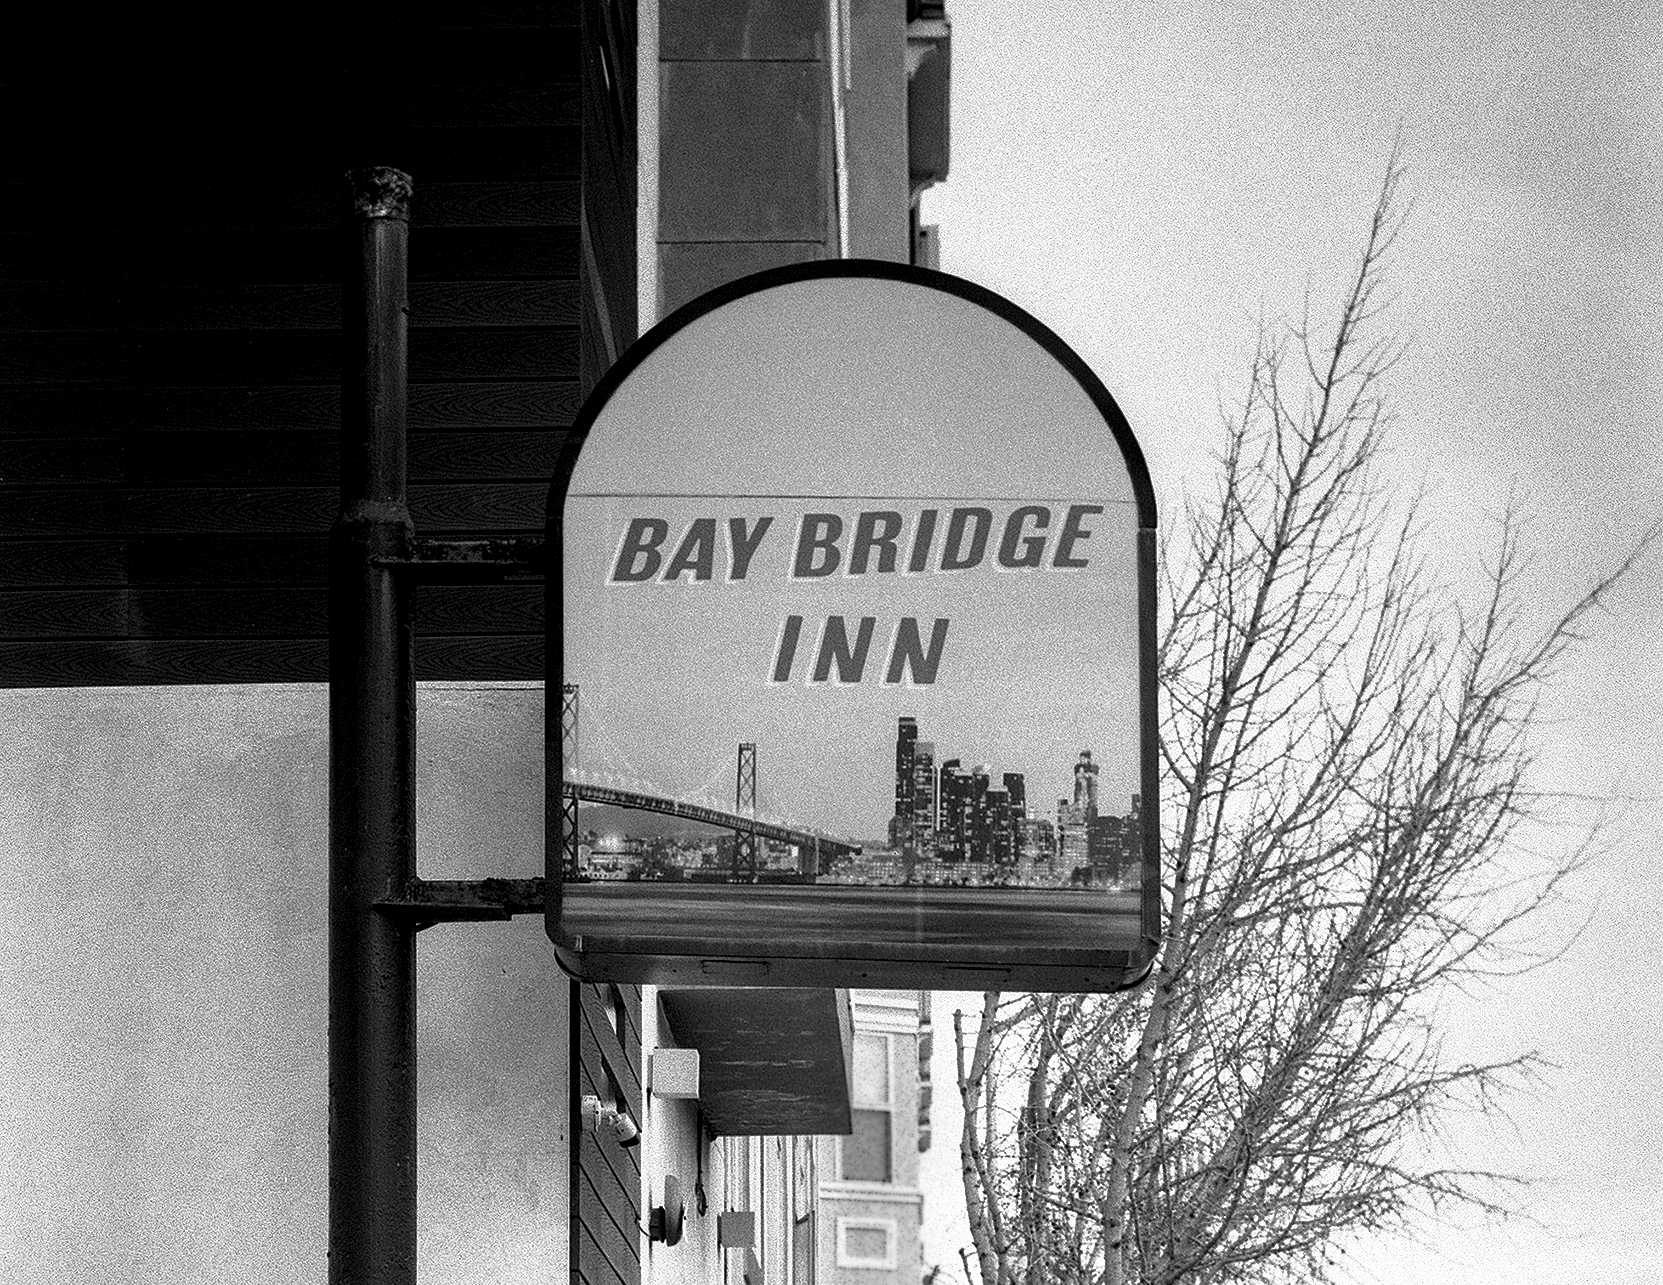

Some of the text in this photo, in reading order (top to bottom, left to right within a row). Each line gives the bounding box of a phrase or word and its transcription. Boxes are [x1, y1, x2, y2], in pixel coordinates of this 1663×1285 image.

[610, 505, 1104, 584] BAY BRIDGE
[769, 614, 951, 686] INN
